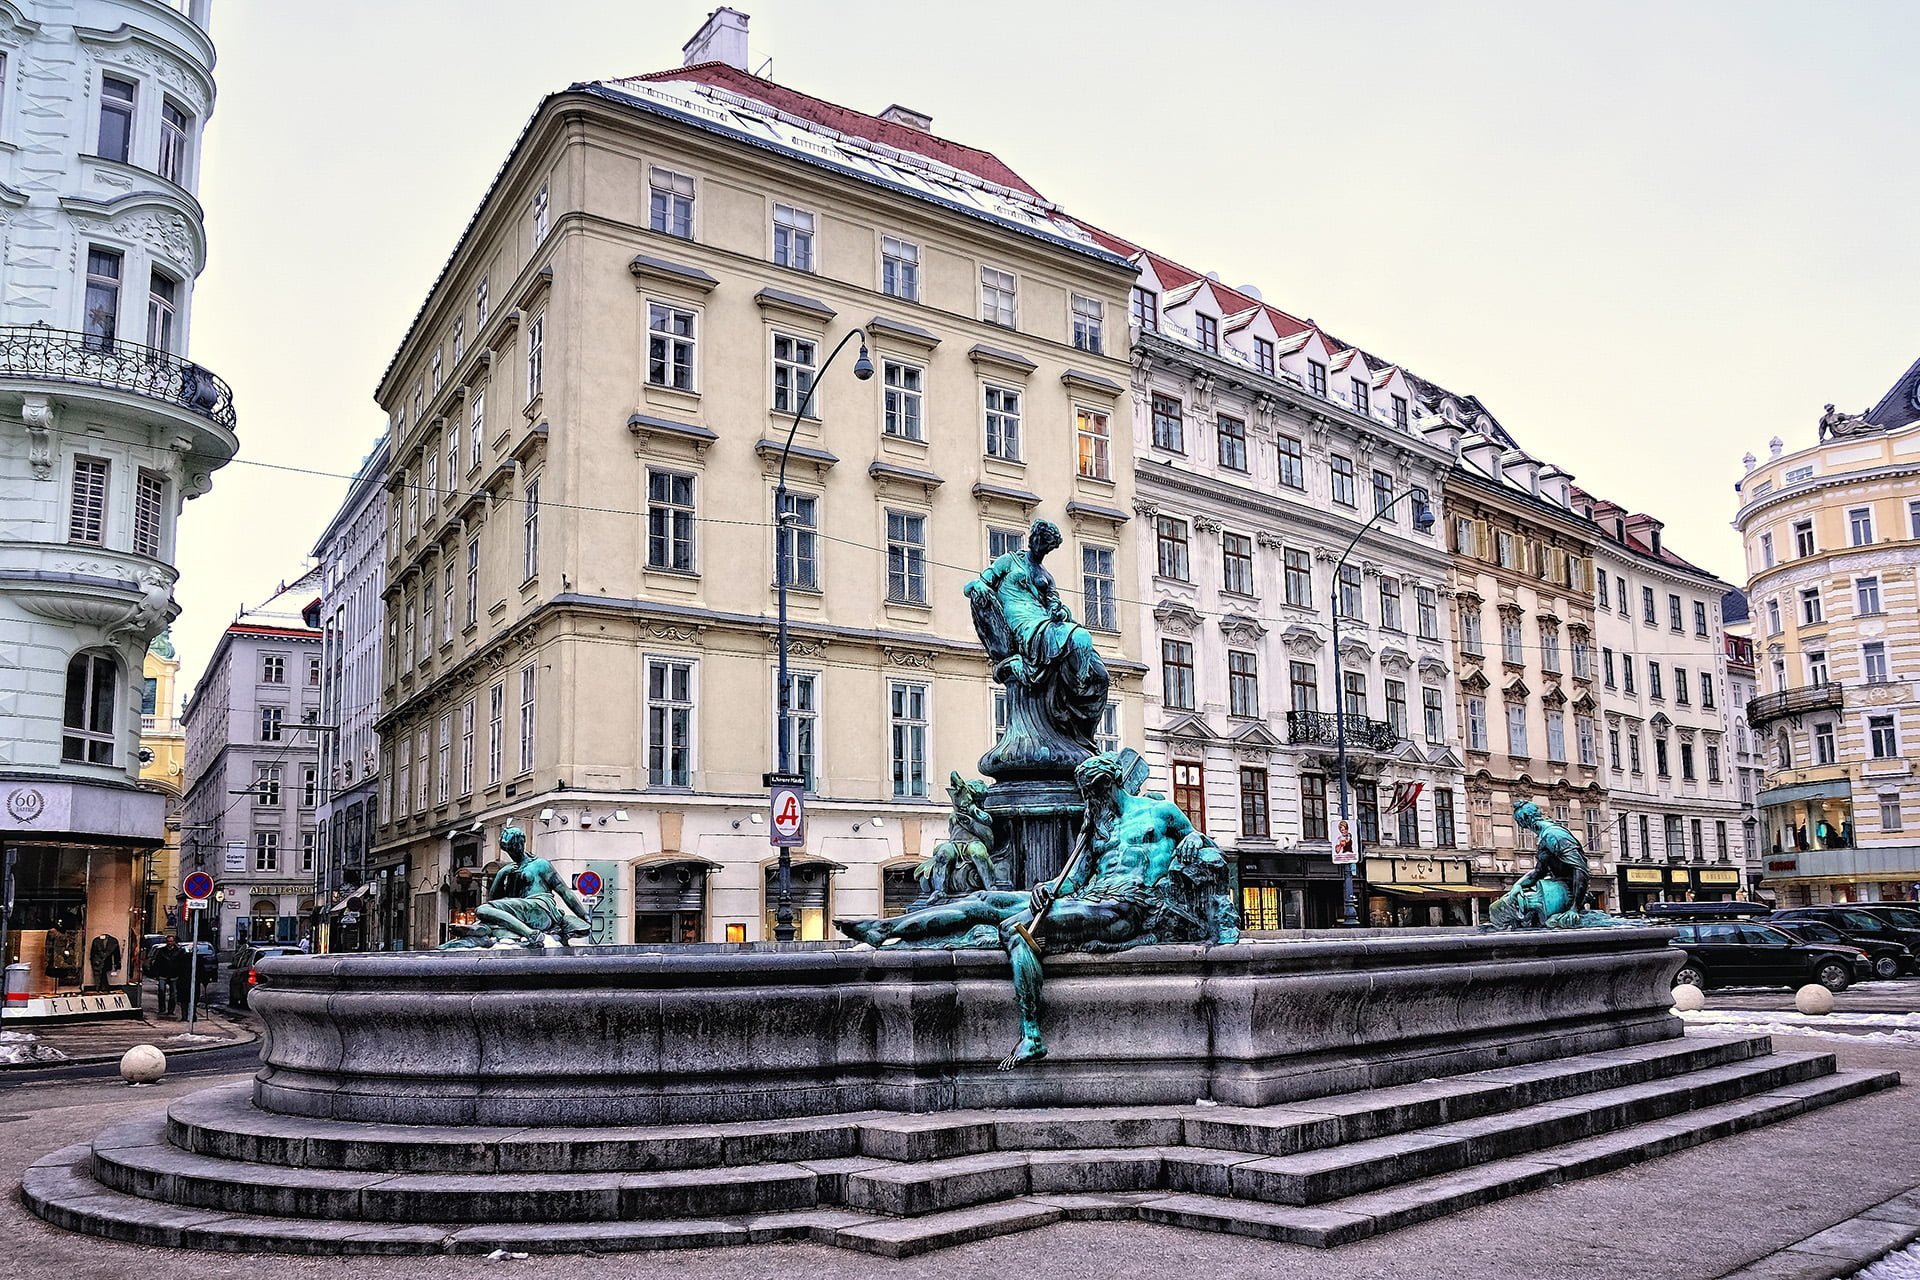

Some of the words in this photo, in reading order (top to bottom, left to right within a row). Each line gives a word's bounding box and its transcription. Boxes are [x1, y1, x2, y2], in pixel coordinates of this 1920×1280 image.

[15, 792, 37, 808] 60
[591, 878, 605, 945] KUN
[51, 996, 125, 1013] FLAMM
